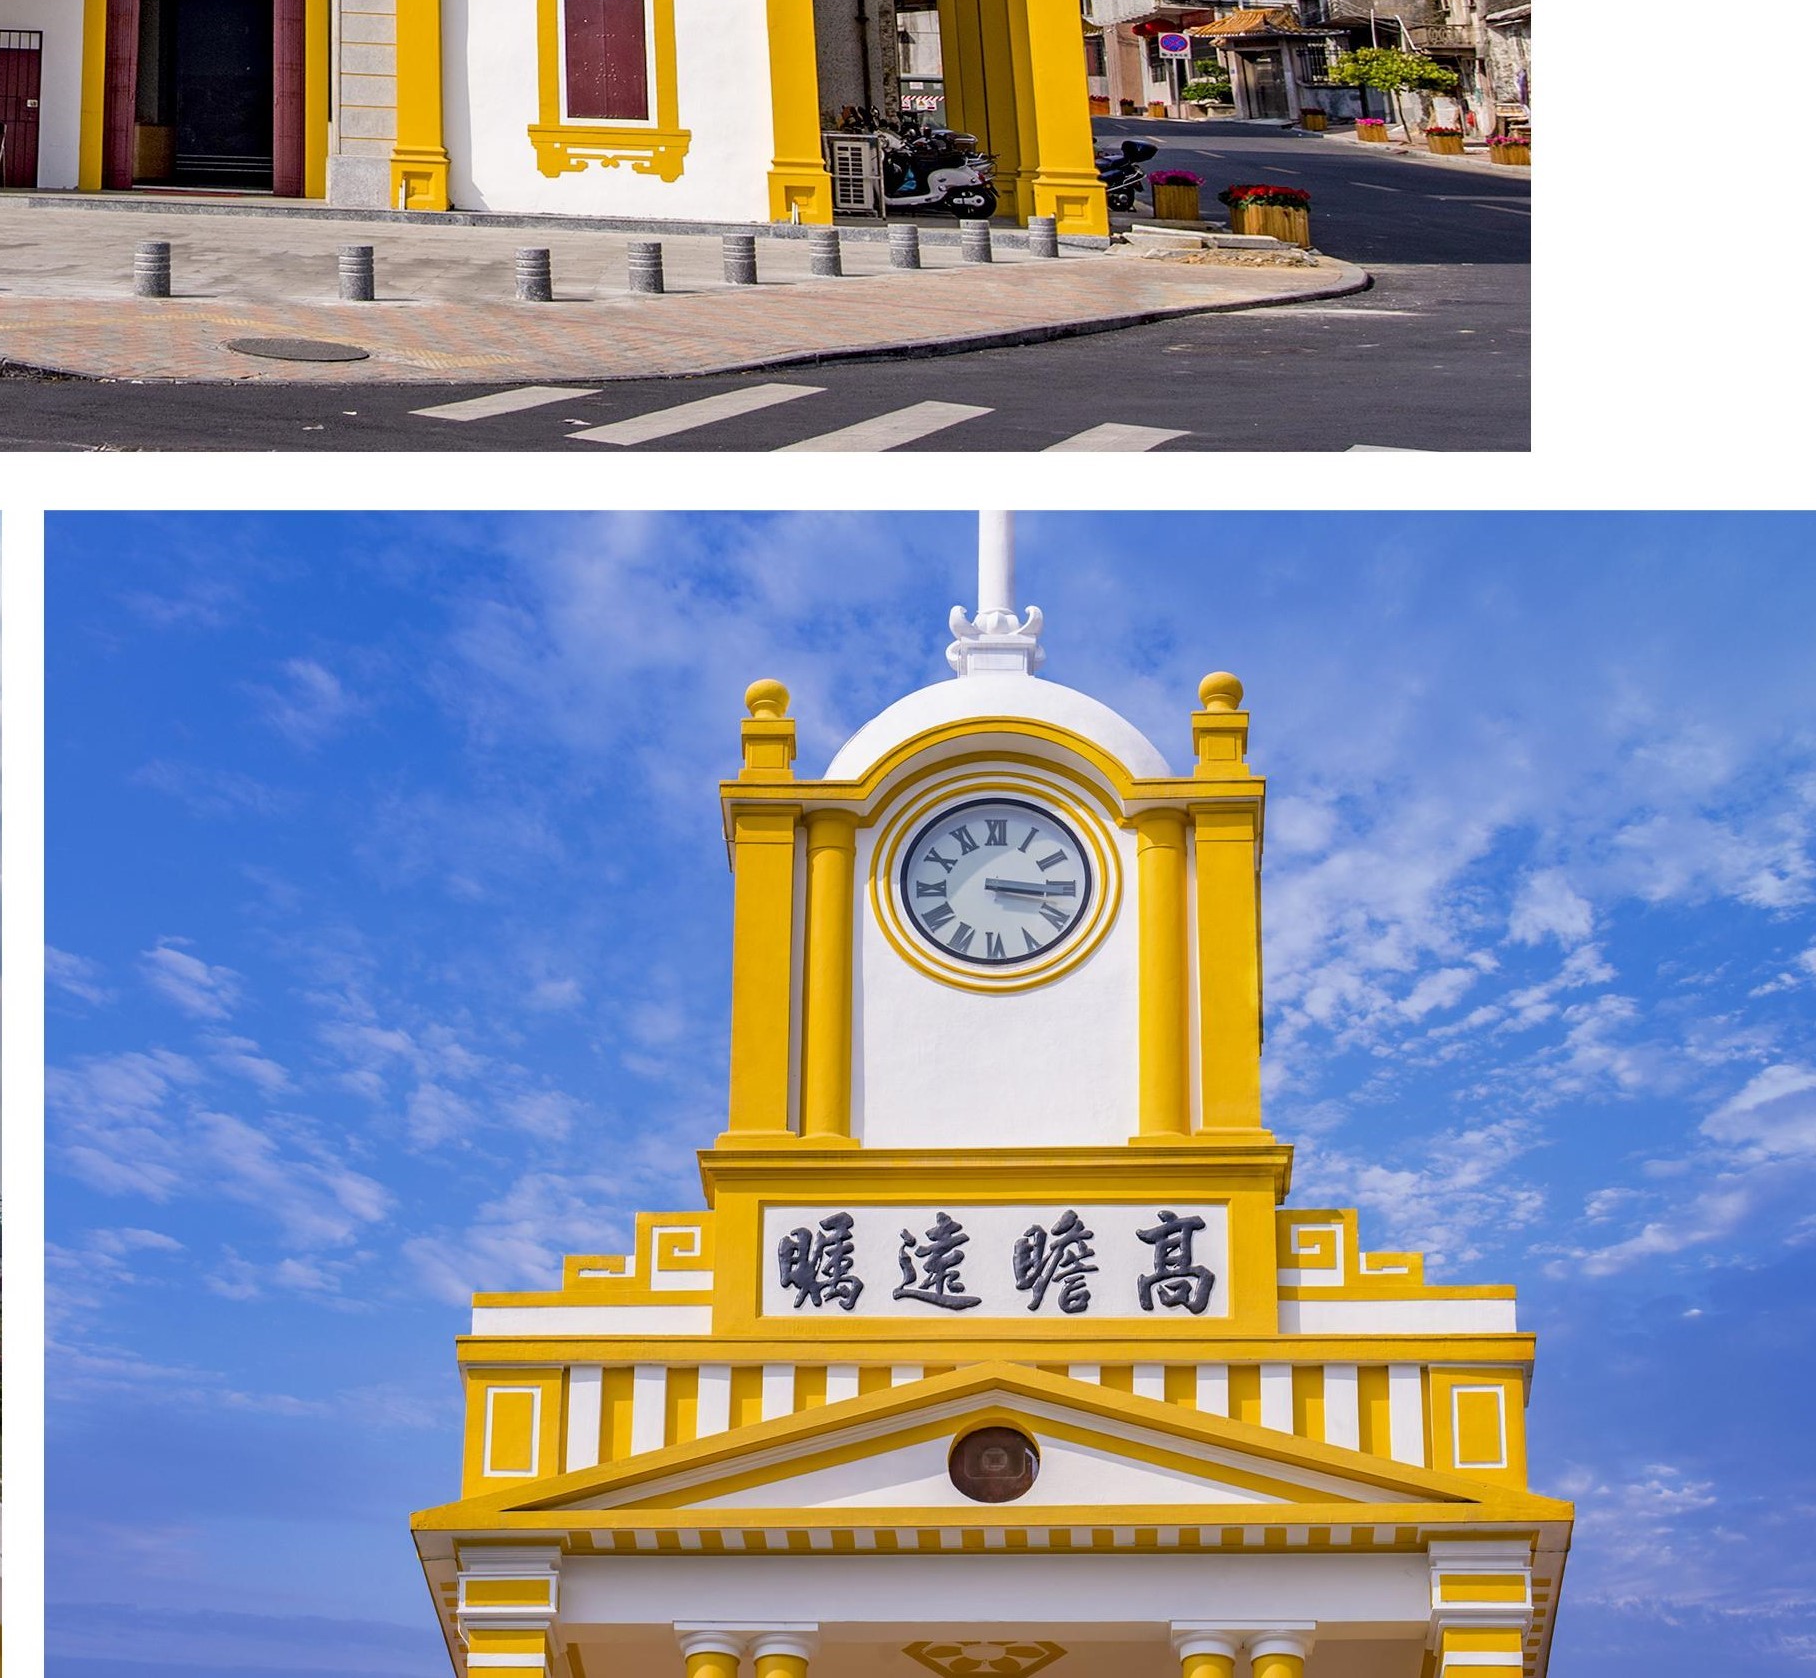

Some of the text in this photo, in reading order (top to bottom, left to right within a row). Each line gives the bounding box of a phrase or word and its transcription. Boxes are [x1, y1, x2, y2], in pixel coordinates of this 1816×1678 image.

[949, 825, 980, 856] XI
[985, 819, 1007, 846] XII
[1018, 827, 1039, 853] I
[924, 847, 958, 873] X
[1036, 849, 1068, 872] II
[917, 880, 946, 898] IX
[1039, 902, 1070, 932] IV
[985, 932, 1006, 959] VI
[1022, 927, 1041, 953] V
